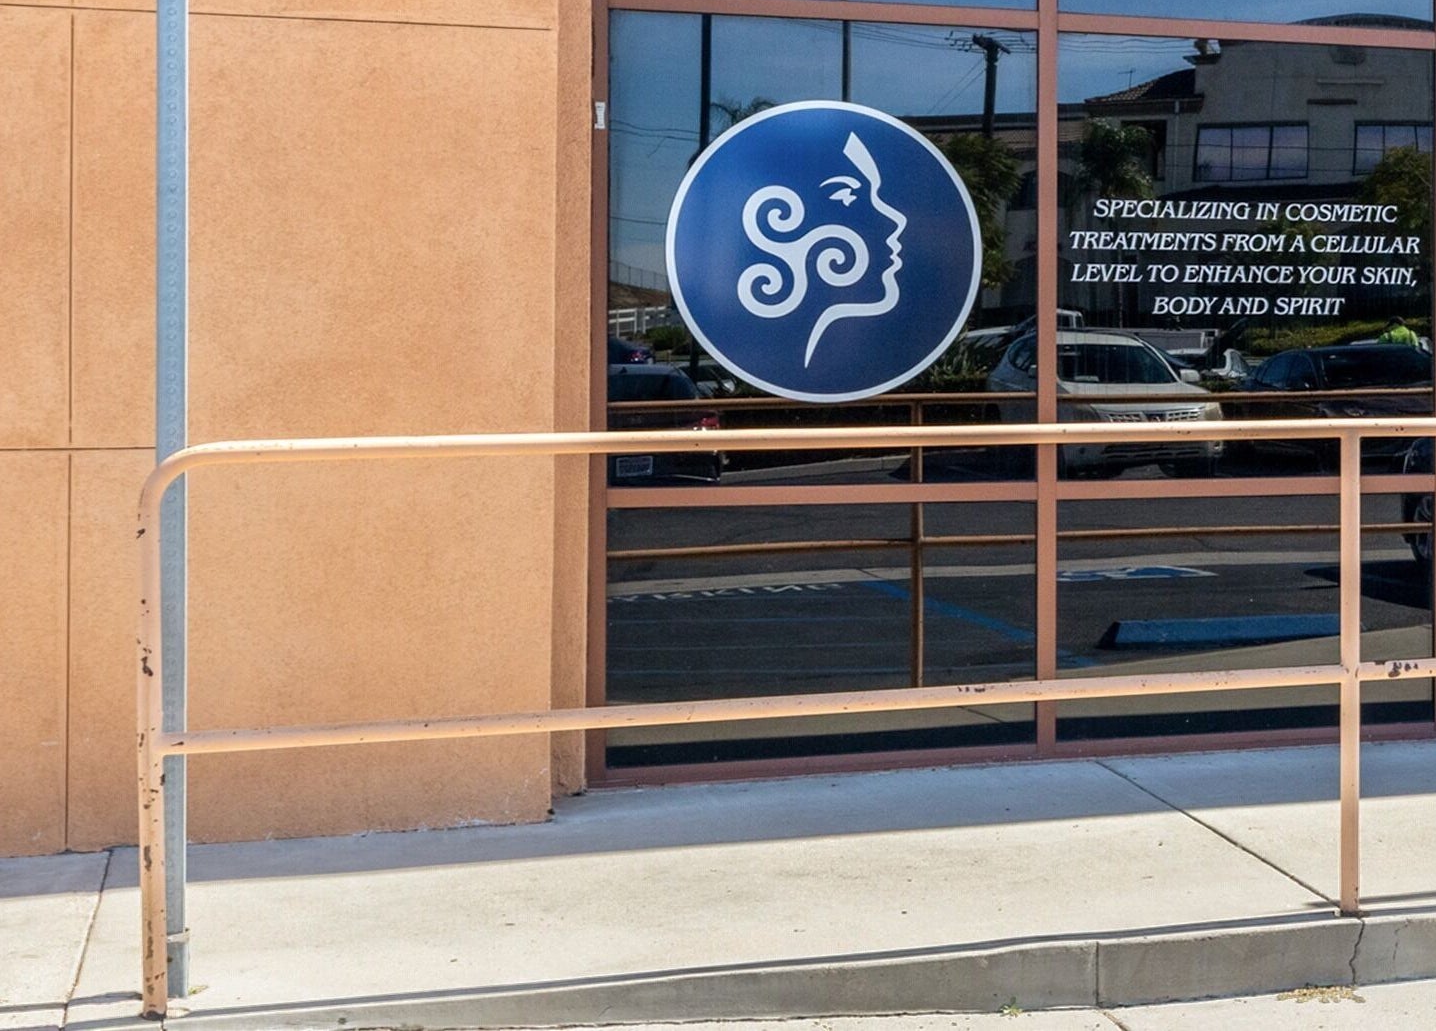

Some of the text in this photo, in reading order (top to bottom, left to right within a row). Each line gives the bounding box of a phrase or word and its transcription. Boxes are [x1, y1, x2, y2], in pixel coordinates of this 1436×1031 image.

[1093, 198, 1398, 223] SPECIALIZING IN COSMETIC
[1069, 231, 1421, 254] TREATMENTS FROM A CELLULAR
[1070, 263, 1418, 287] LEVEL TO ENHANCE YOUR SKIN,
[1152, 296, 1345, 316] BODY AND SPIRIT
